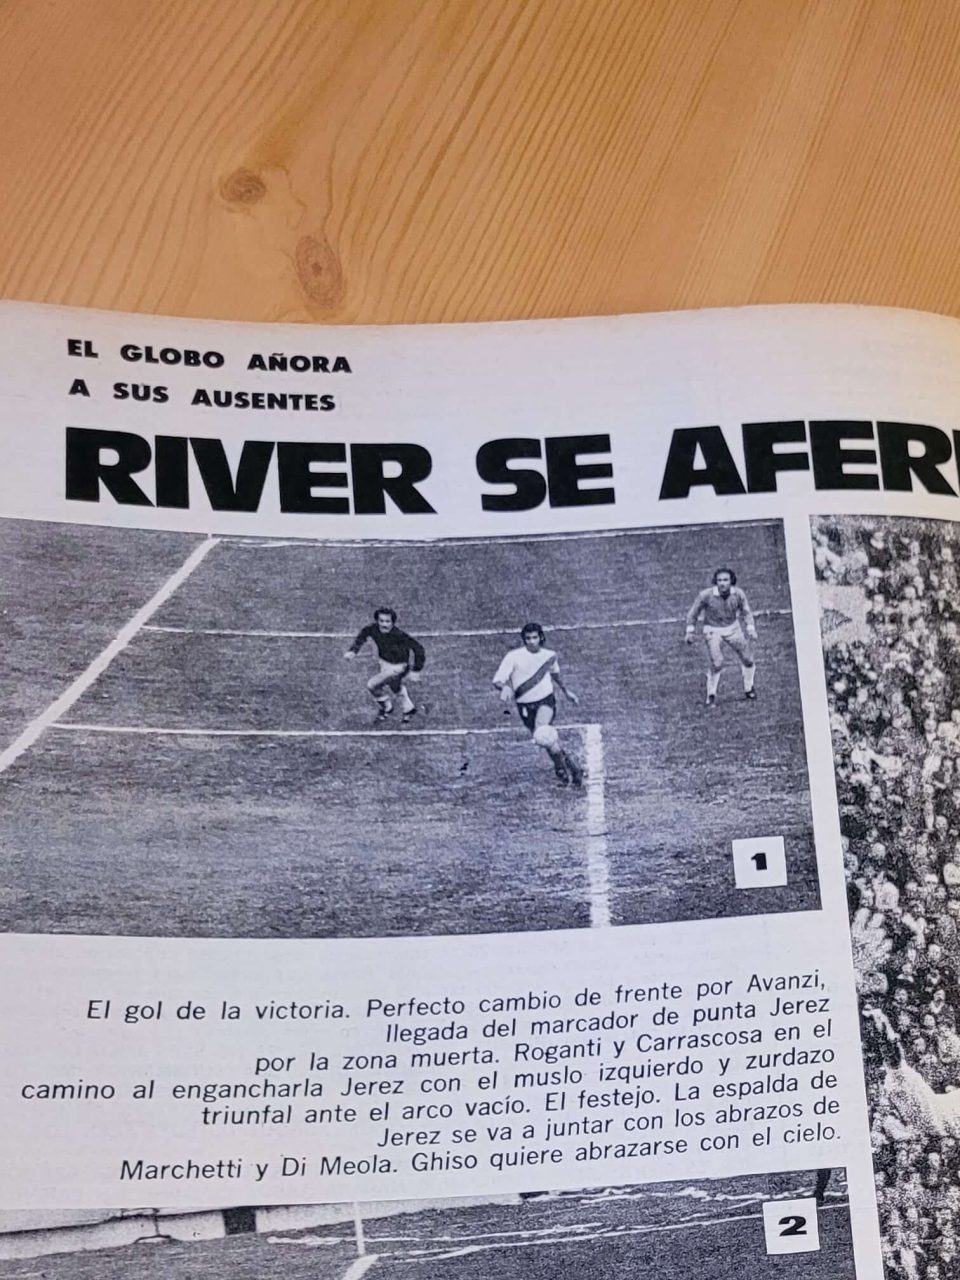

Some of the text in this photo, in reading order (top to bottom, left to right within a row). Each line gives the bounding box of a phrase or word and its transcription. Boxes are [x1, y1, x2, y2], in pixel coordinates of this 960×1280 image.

[67, 338, 352, 374] EL GLOBO AÑORA
[68, 378, 336, 412] A SUS AUSENTES
[66, 427, 436, 514] RIVER
[476, 434, 615, 511] SE
[751, 852, 767, 871] 1
[87, 969, 825, 1024] El gol de la victoria. Perfecto cambio de frente por Avanzi,
[386, 997, 830, 1046] llegada del marcador de punta Jerez
[255, 1018, 832, 1075] por la zona muerta. Roganti y Carrascosa en el
[21, 1046, 835, 1103] camino al engancharla Jerez con el muslo izquierdo y zurdazo
[201, 1070, 837, 1125] triunfal ante el arco vacío. El festejo. La espalda de
[377, 1095, 840, 1147] Jerez se va a juntar con los abrazos de
[120, 1122, 840, 1181] Marchetti y Di Meola. Ghiso quiere abrazarse con el cielo.
[778, 1215, 807, 1237] 2
